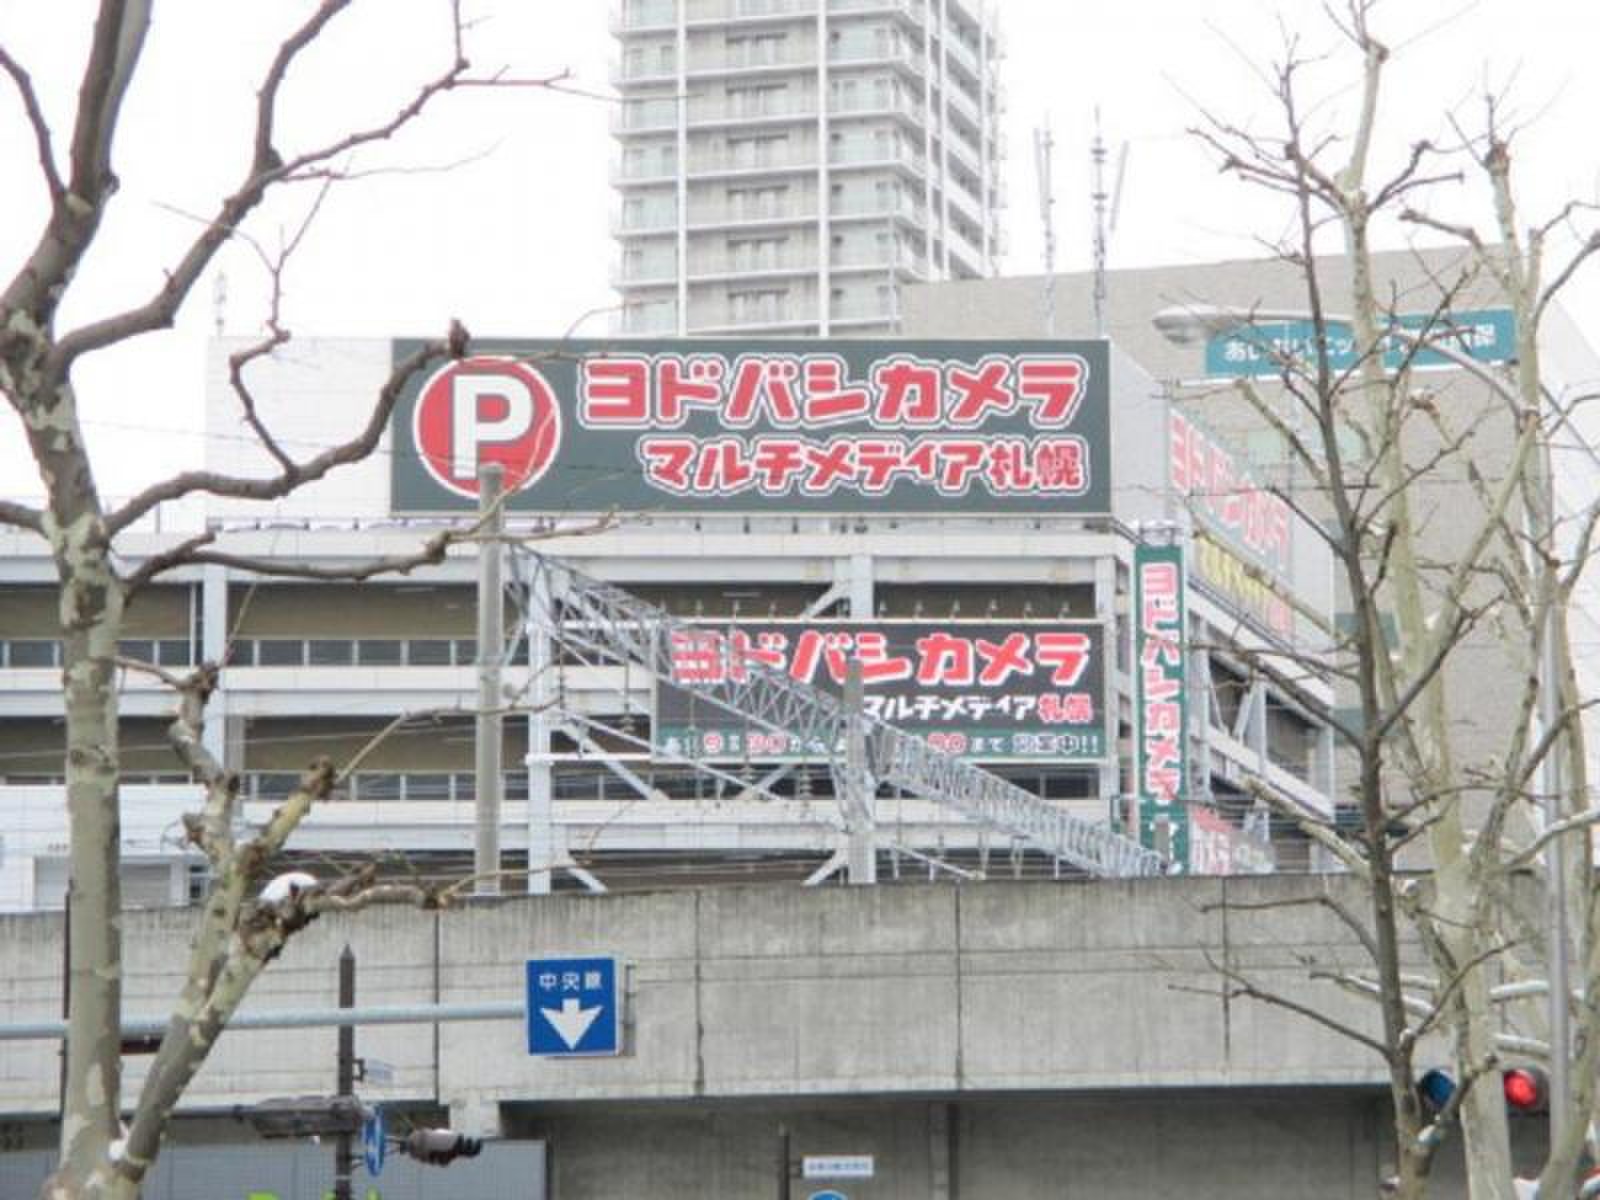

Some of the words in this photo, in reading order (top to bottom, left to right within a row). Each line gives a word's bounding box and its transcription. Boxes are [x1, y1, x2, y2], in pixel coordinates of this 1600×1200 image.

[453, 375, 534, 479] P
[580, 354, 1088, 427] ヨドバシカメラ
[640, 437, 1087, 494] マルチメディア札幌
[671, 632, 1091, 686] ヨドバシカメラ
[1140, 563, 1181, 803] ヨドバシカメラ
